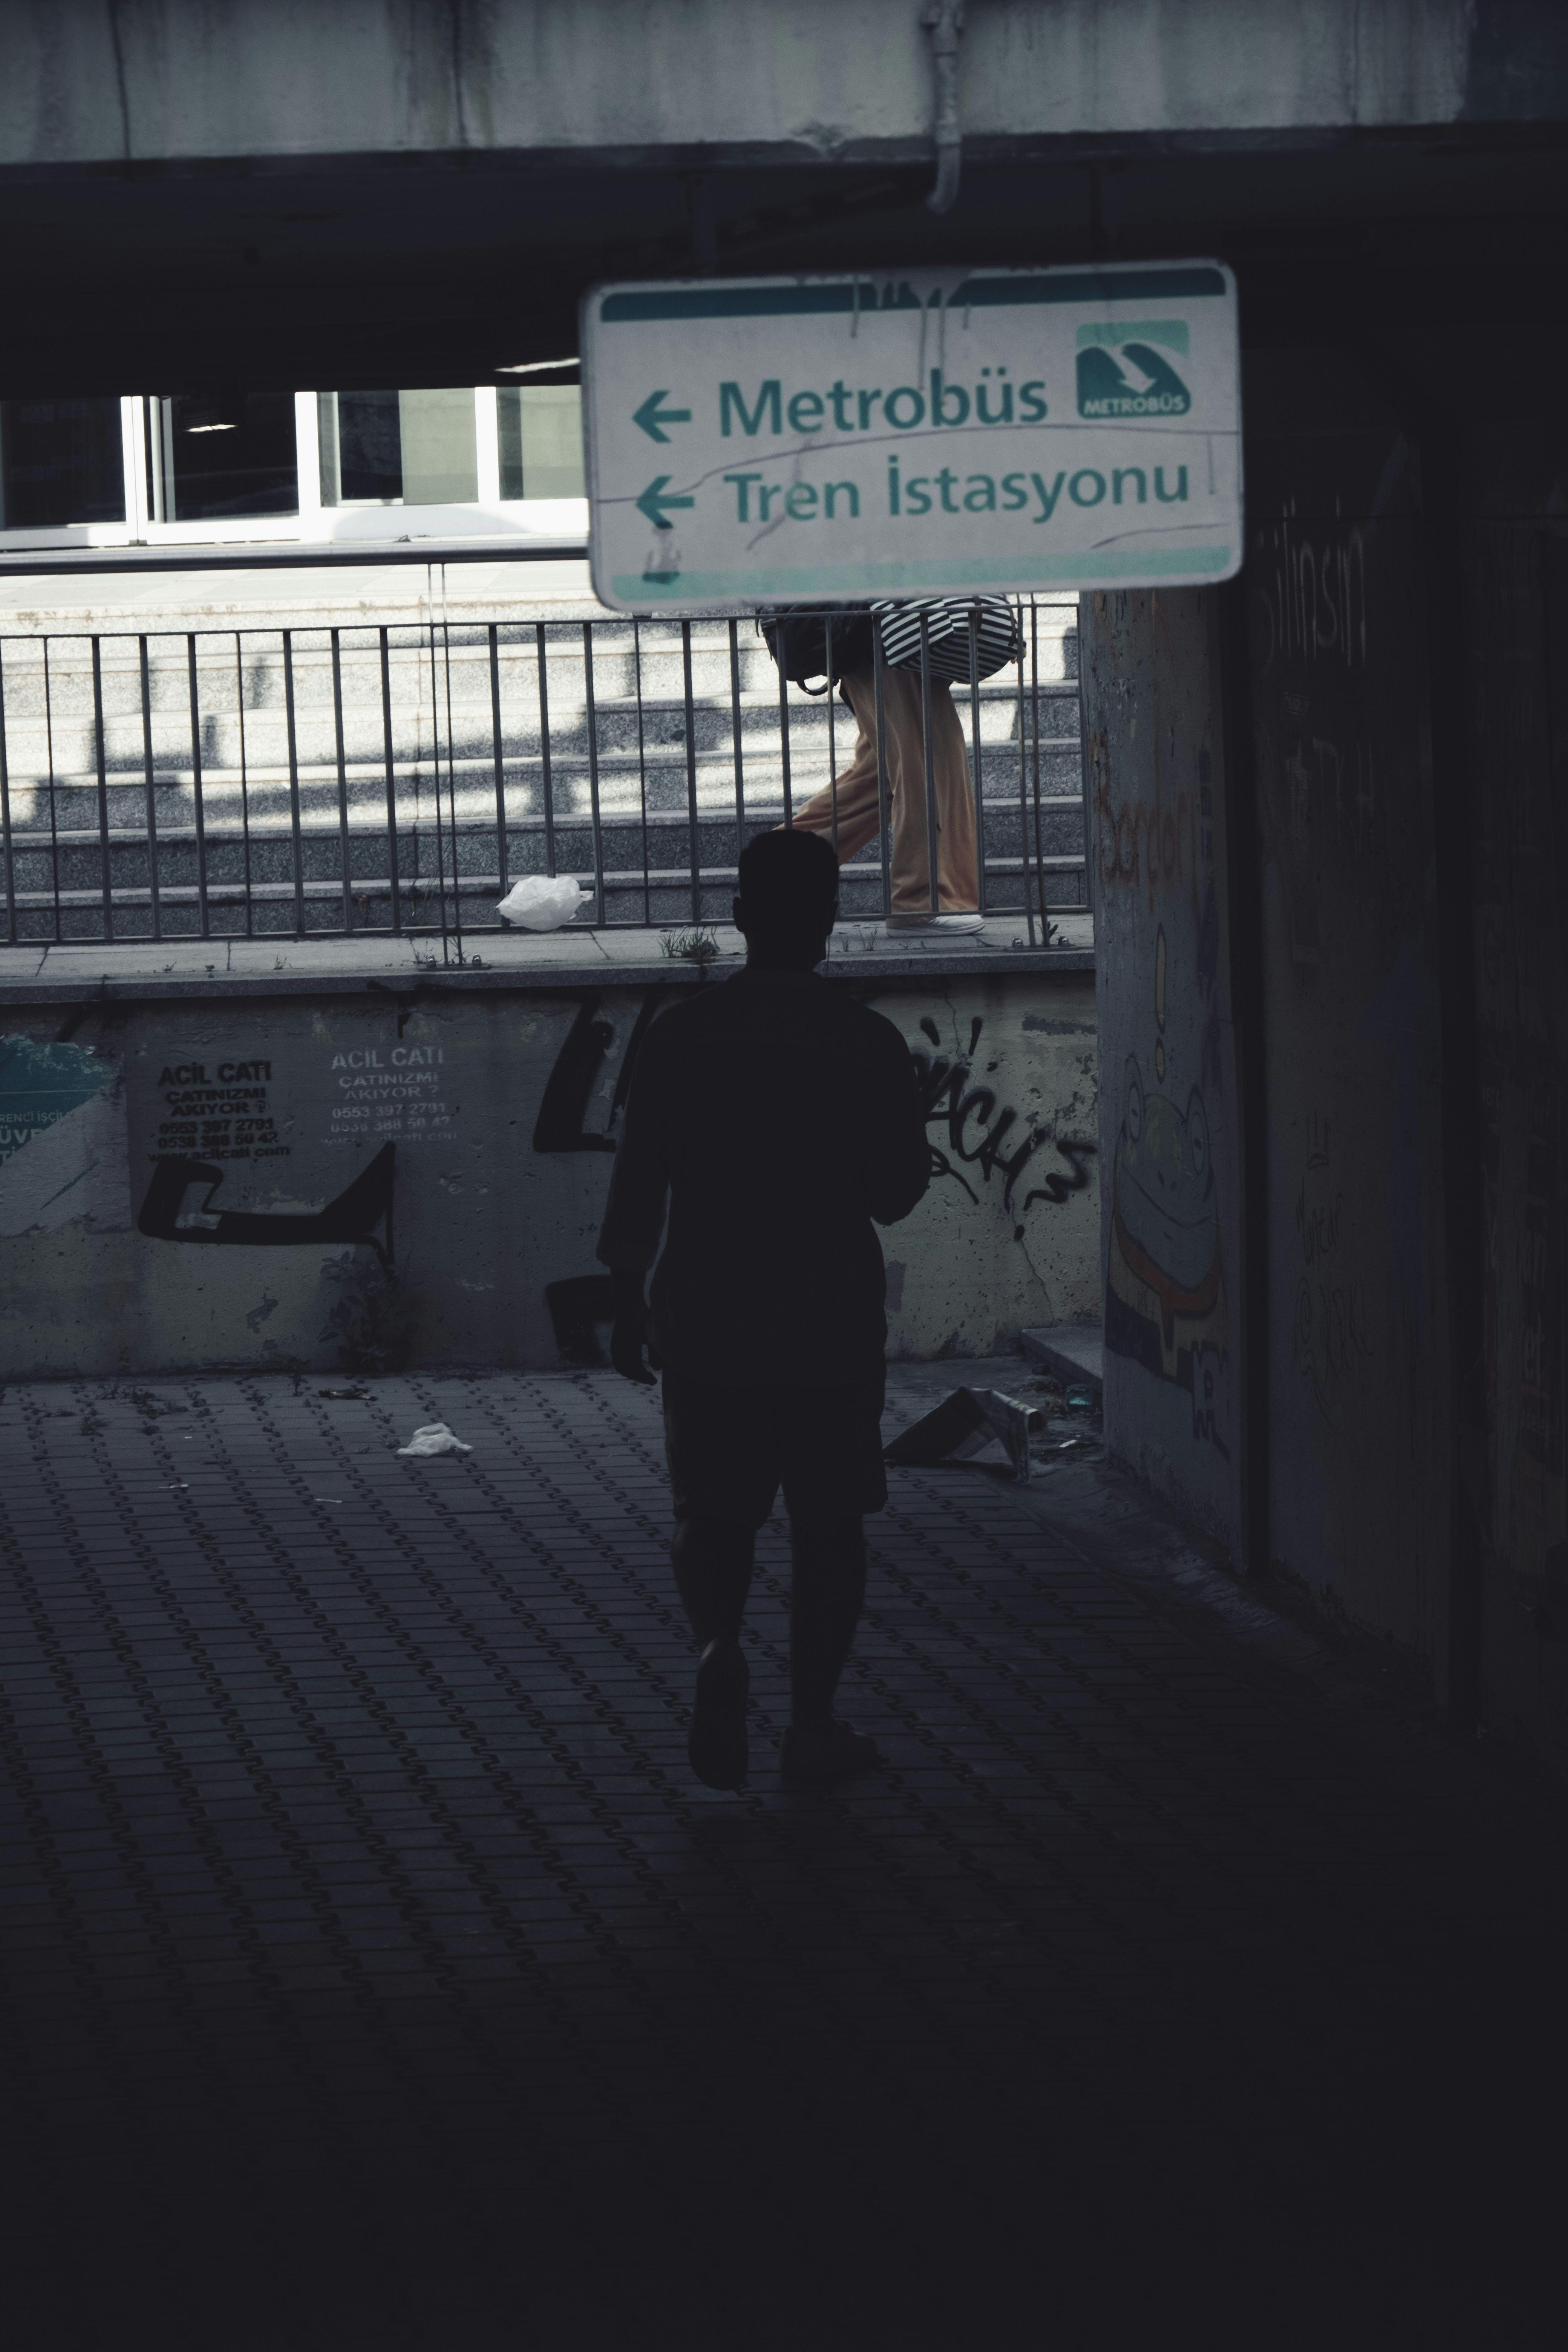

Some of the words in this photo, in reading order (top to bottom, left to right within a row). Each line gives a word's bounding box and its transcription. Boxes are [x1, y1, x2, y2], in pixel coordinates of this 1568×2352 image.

[720, 367, 1048, 437] Metrobüs
[1084, 392, 1185, 414] METROBÜS
[723, 473, 860, 523] Tren
[888, 454, 1189, 524] İstasyonu
[331, 1047, 385, 1069] ACİL
[158, 1061, 211, 1086] ACİL
[345, 1087, 421, 1100] AKIYOR
[170, 1102, 250, 1116] AKIYOR
[332, 1106, 370, 1118] 0553
[376, 1104, 403, 1116] 397
[409, 1102, 446, 1115] 2791
[159, 1121, 198, 1135] 0553
[201, 1119, 231, 1133] 397
[236, 1117, 274, 1131] 2791
[158, 1136, 196, 1148] 0538
[235, 1133, 254, 1145] 50
